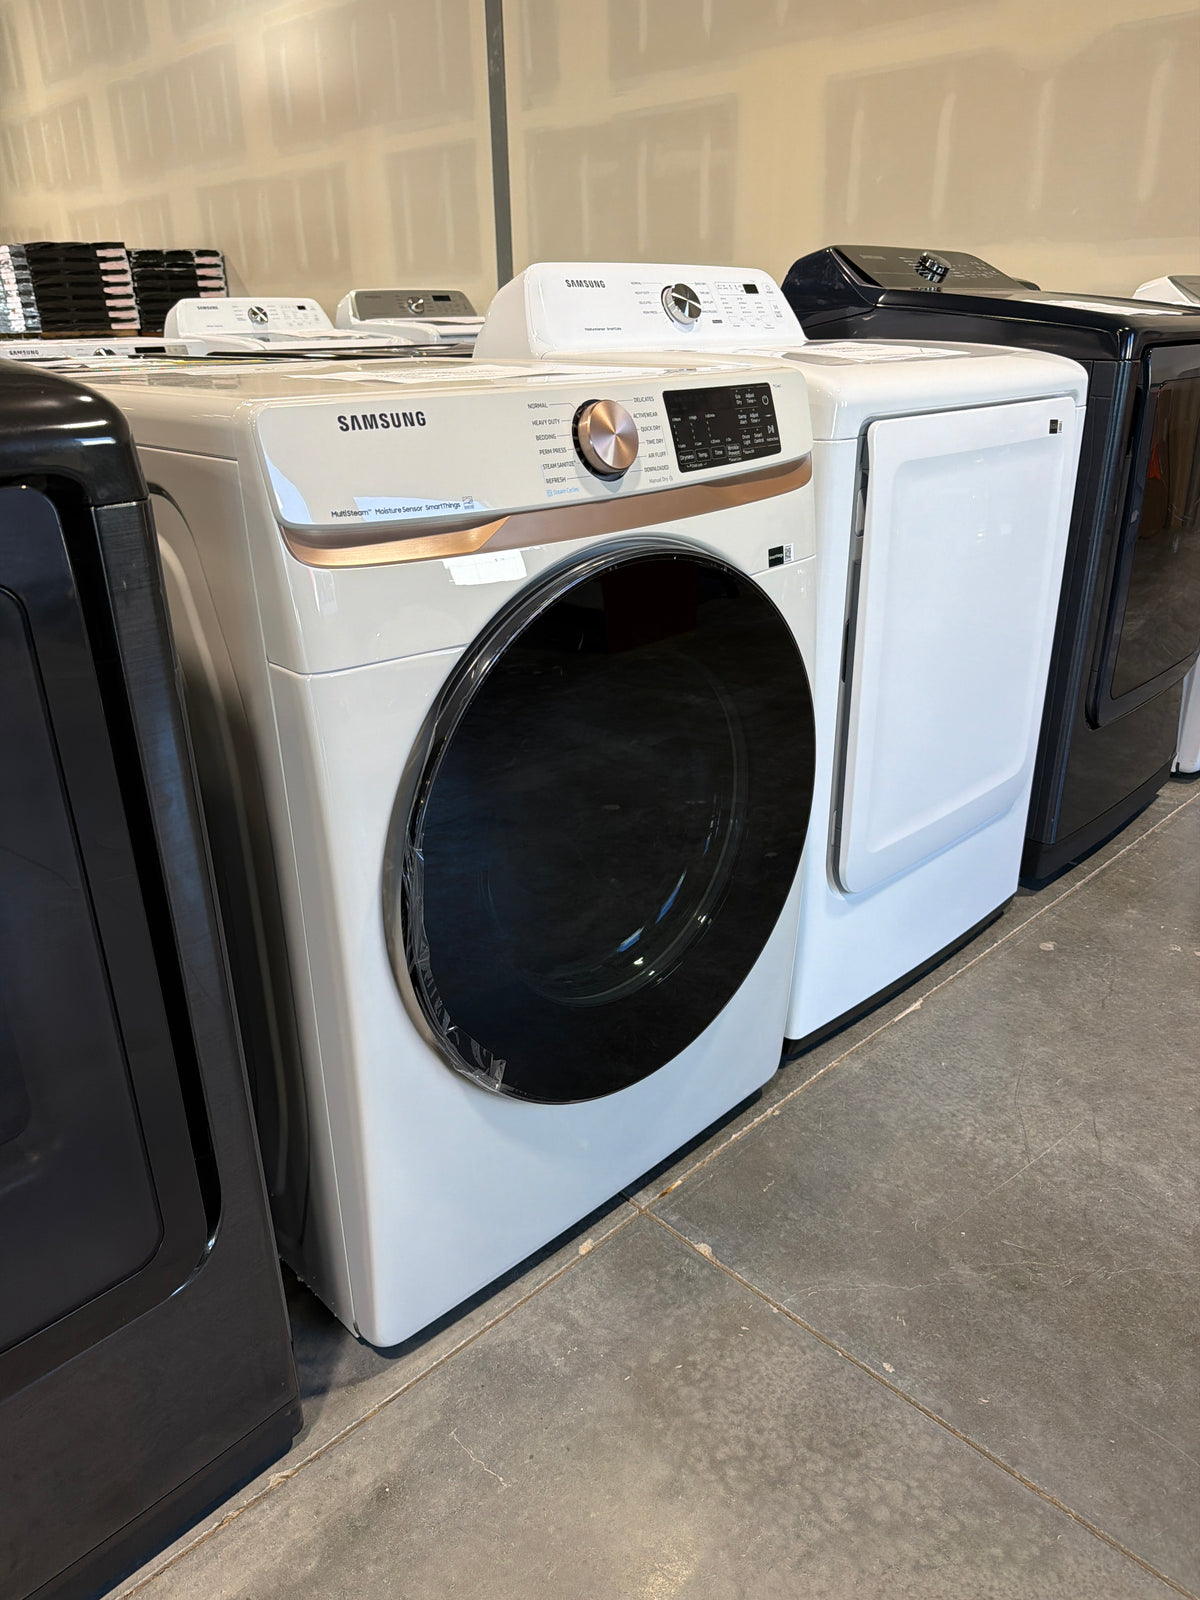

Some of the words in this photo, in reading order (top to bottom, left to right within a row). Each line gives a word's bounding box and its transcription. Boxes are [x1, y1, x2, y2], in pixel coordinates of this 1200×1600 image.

[565, 279, 606, 288] SAMSUNG
[633, 411, 658, 419] ACTIVEWEAR
[337, 411, 427, 432] SAMSUNG
[640, 425, 653, 433] QUICK
[535, 433, 557, 441] BEDDING
[542, 462, 557, 470] STEAM
[644, 464, 670, 472] DOWNLOADED
[546, 476, 567, 484] REFRESH
[375, 507, 402, 516] Moisture
[402, 505, 423, 513] Sensor
[425, 501, 461, 511] SmartThings
